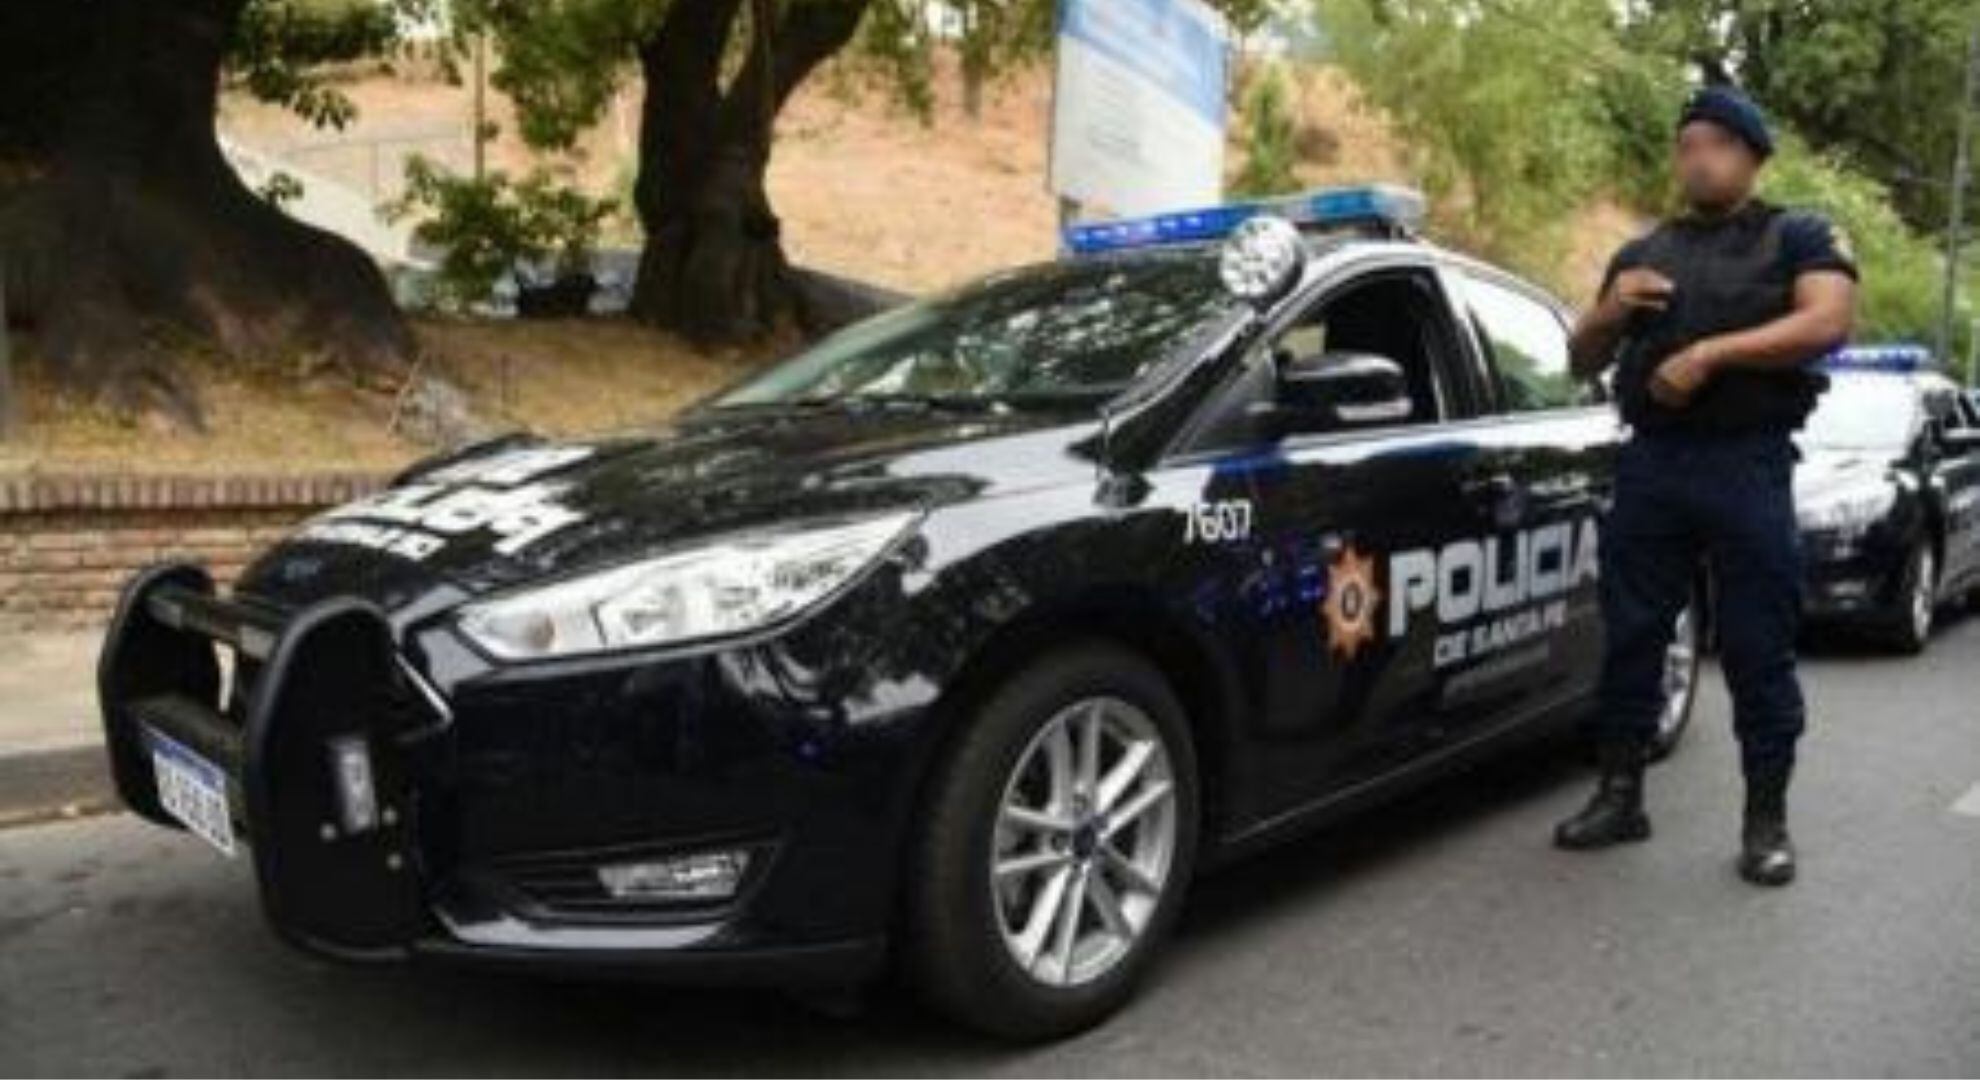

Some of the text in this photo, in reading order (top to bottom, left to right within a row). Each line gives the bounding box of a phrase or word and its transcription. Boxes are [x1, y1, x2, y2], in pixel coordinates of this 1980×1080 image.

[1183, 498, 1252, 544] 7607
[1389, 516, 1599, 637] POLICIA
[1434, 629, 1467, 668] DE
